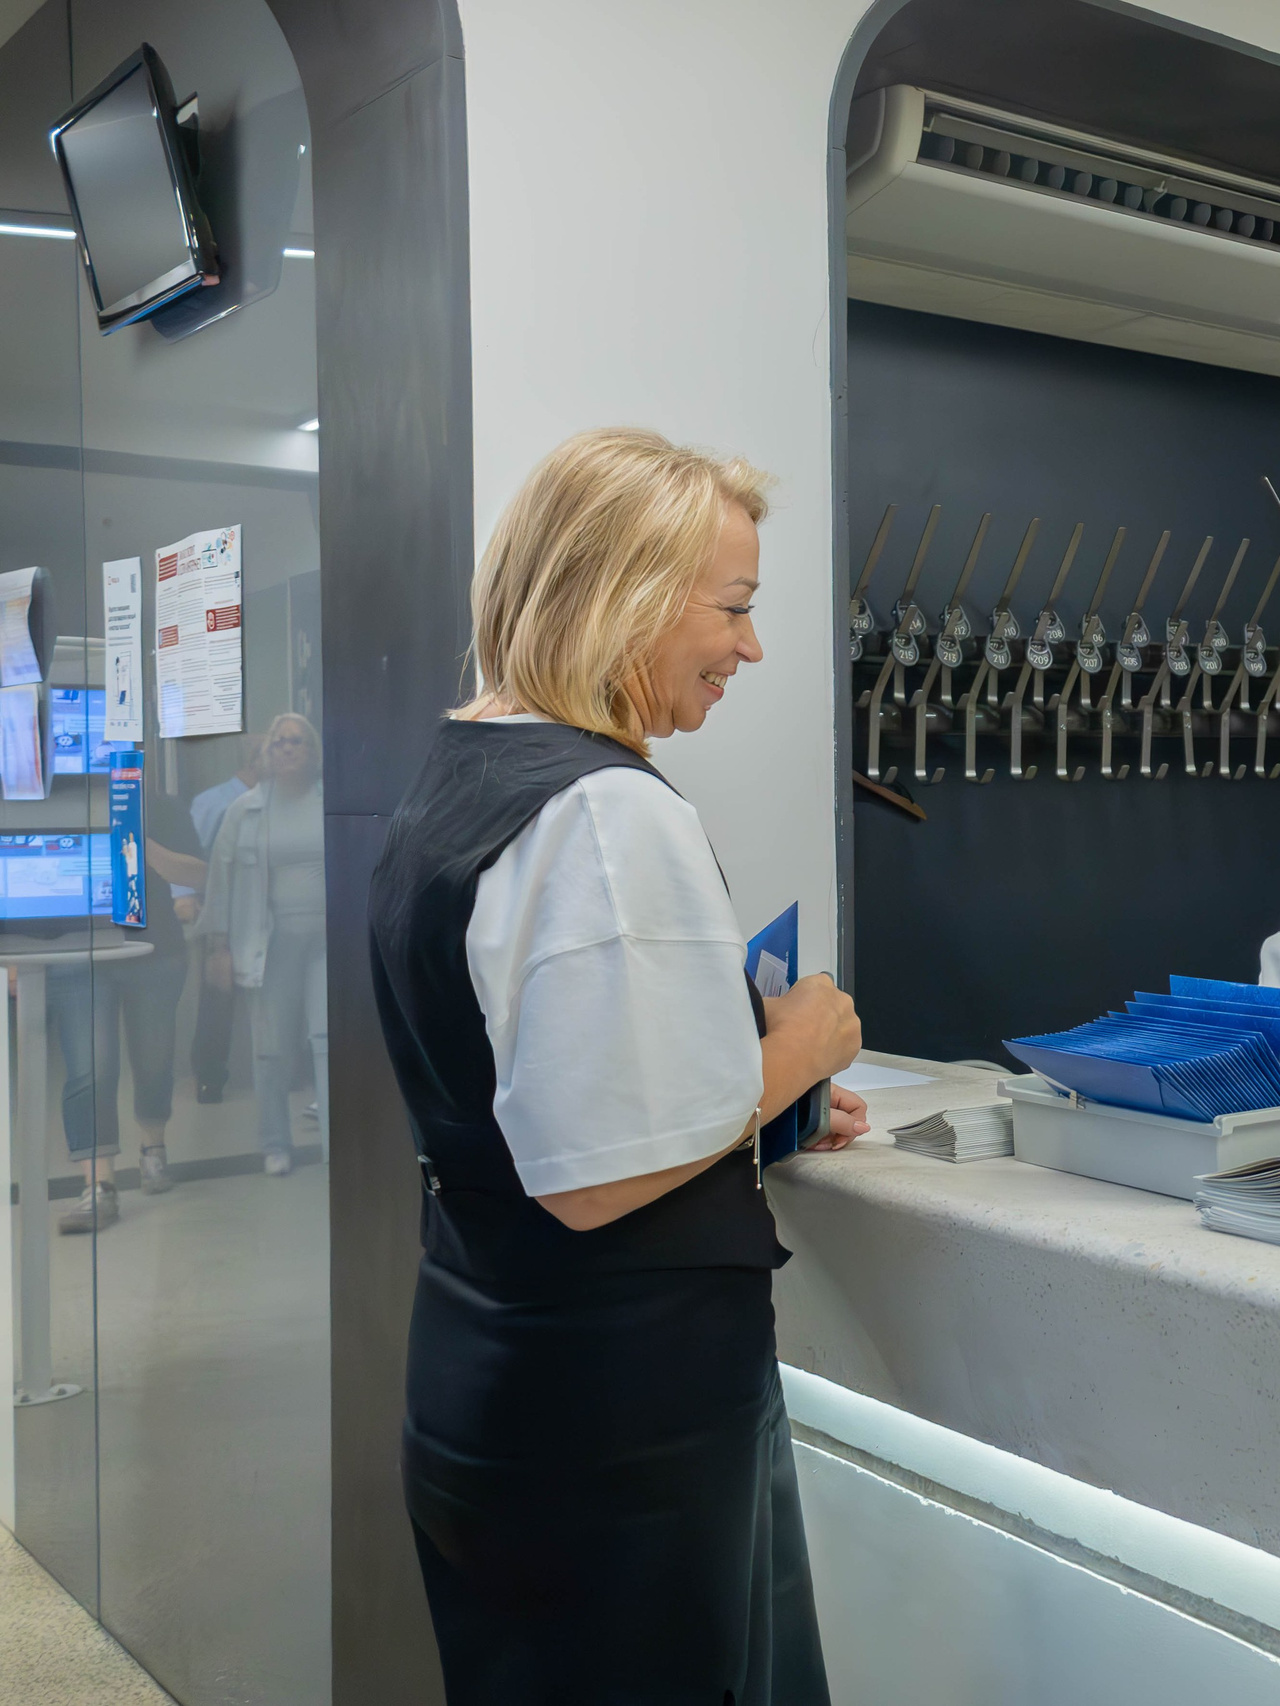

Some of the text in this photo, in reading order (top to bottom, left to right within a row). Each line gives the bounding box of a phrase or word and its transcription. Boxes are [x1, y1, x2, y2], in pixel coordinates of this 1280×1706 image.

[853, 619, 868, 629] 216
[1092, 634, 1103, 642] 06
[899, 649, 914, 660] 215
[943, 651, 957, 663] 213
[993, 654, 1005, 664] 211
[1033, 655, 1049, 665] 209
[1084, 659, 1098, 667] 207
